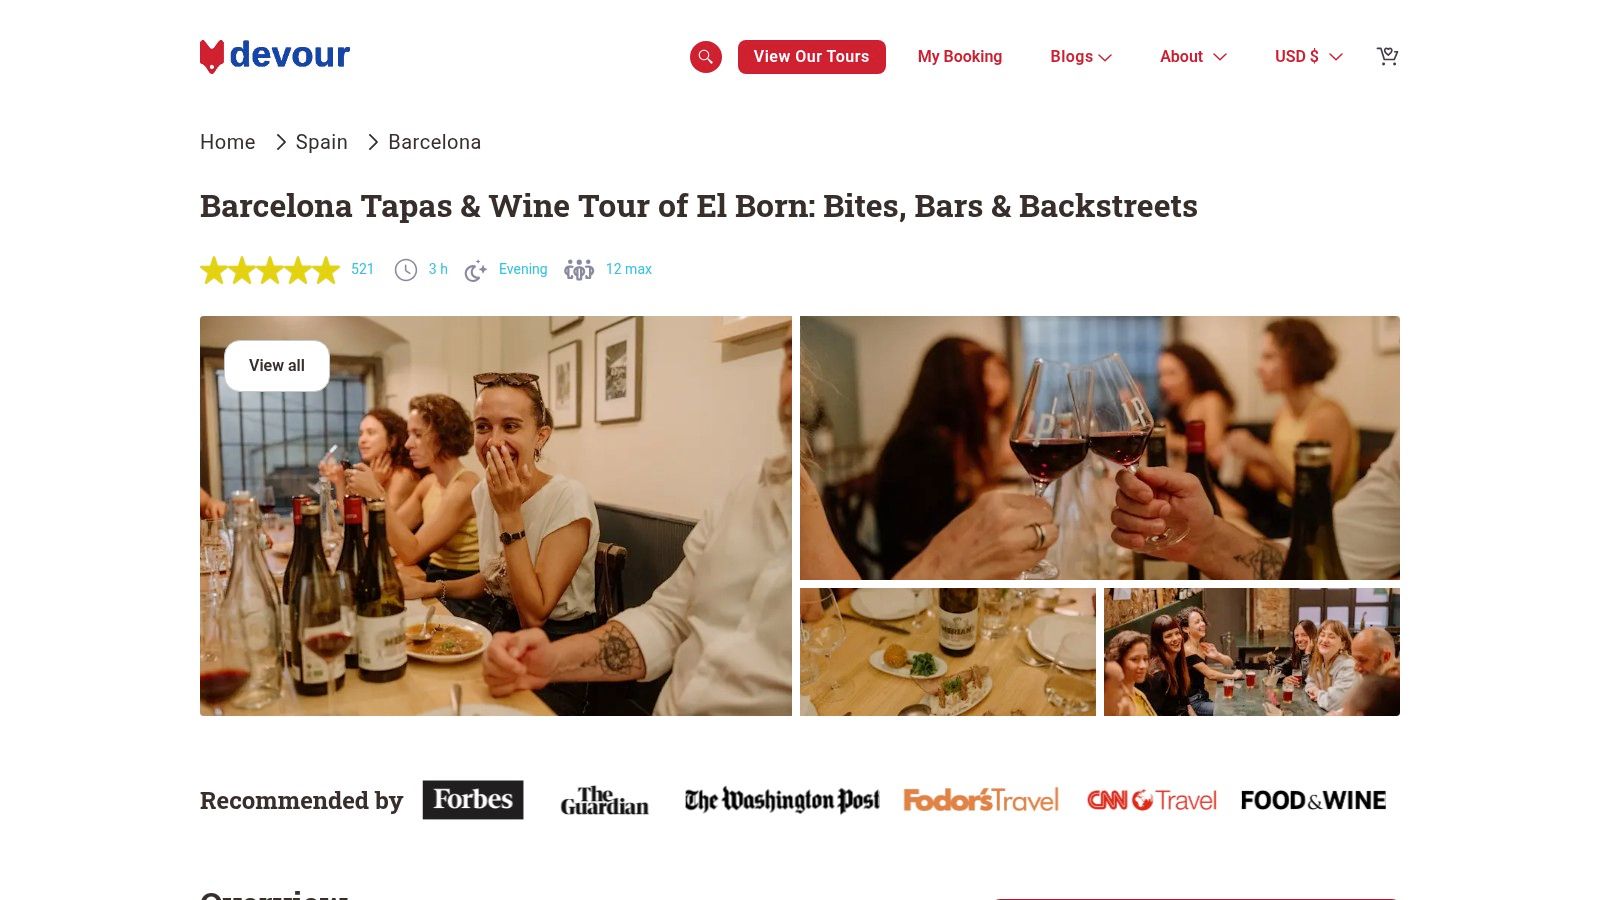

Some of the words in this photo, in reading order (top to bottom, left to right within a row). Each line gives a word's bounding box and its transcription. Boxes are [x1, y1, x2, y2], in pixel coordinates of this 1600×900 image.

[231, 40, 350, 67] devour
[753, 50, 790, 63] View
[795, 50, 822, 63] Our
[827, 50, 869, 63] Tours
[918, 50, 940, 66] My
[944, 49, 1002, 66] Booking
[1051, 49, 1093, 66] Blogs
[1160, 49, 1203, 63] About
[1275, 50, 1306, 63] USD
[1310, 48, 1319, 65] $
[201, 133, 255, 150] Home
[296, 133, 347, 154] Spain
[389, 133, 481, 150] Barcelona
[201, 193, 352, 218] Barcelona
[361, 194, 452, 223] Tapas
[461, 194, 480, 218] &
[489, 193, 569, 218] Wine
[579, 194, 650, 218] Tour
[659, 193, 689, 218] of
[697, 193, 727, 218] El
[736, 194, 814, 218] Born:
[824, 193, 906, 223] Bites,
[915, 194, 982, 218] Bars
[992, 194, 1011, 218] &
[1020, 193, 1198, 218] Backstreets
[351, 263, 374, 275] 521
[429, 263, 437, 275] 3
[440, 263, 448, 275] h
[499, 263, 547, 278] Evening
[606, 263, 622, 275] 12
[625, 266, 652, 275] max
[249, 359, 285, 372] View
[288, 359, 305, 372] all
[433, 788, 514, 810] Forbes
[577, 785, 614, 802] The
[685, 789, 719, 813] The
[721, 786, 834, 814] Washington
[837, 788, 880, 814] Post
[1088, 790, 1128, 810] CNN
[1155, 790, 1217, 810] Travel
[200, 791, 370, 810] Recommended
[375, 791, 404, 815] by
[561, 798, 649, 815] Guardian
